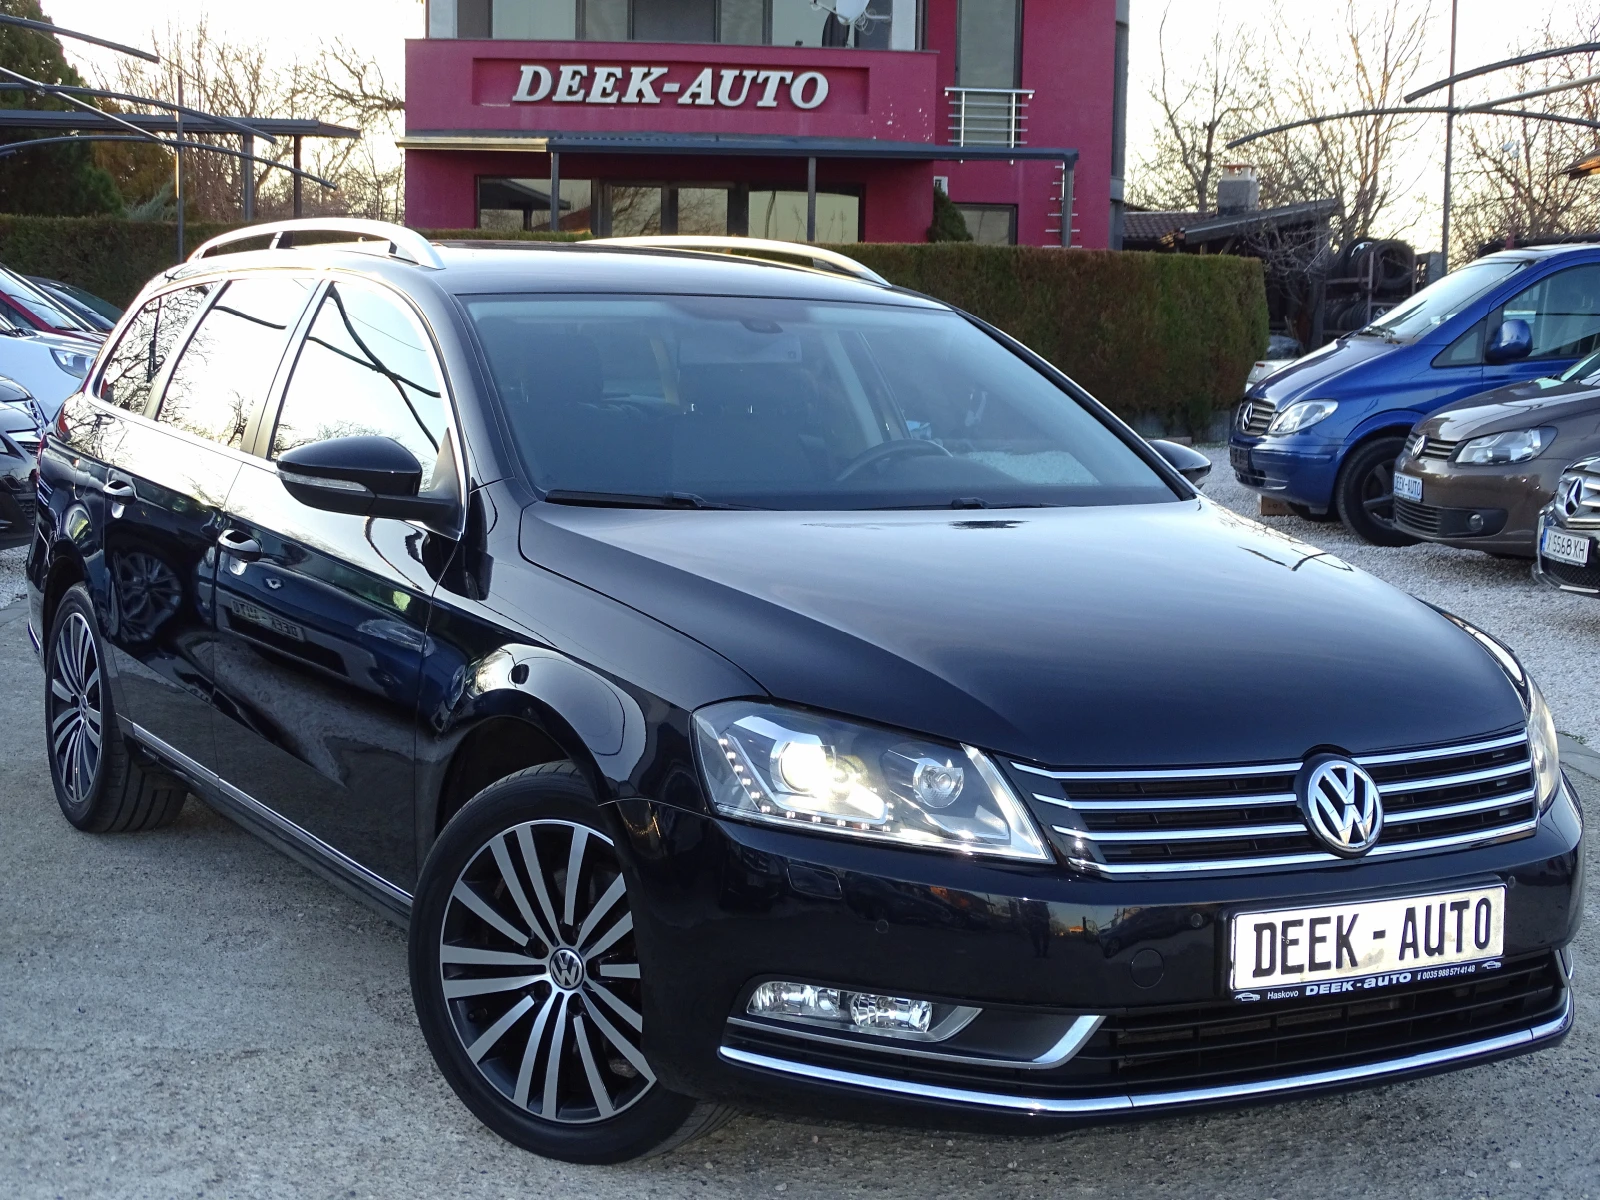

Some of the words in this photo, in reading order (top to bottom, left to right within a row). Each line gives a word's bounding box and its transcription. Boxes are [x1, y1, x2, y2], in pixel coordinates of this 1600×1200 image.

[512, 65, 829, 109] DEEK-AUTO
[1252, 914, 1360, 978] DEEK
[1399, 897, 1492, 961] AUTO
[1267, 991, 1299, 1000] Haskovo
